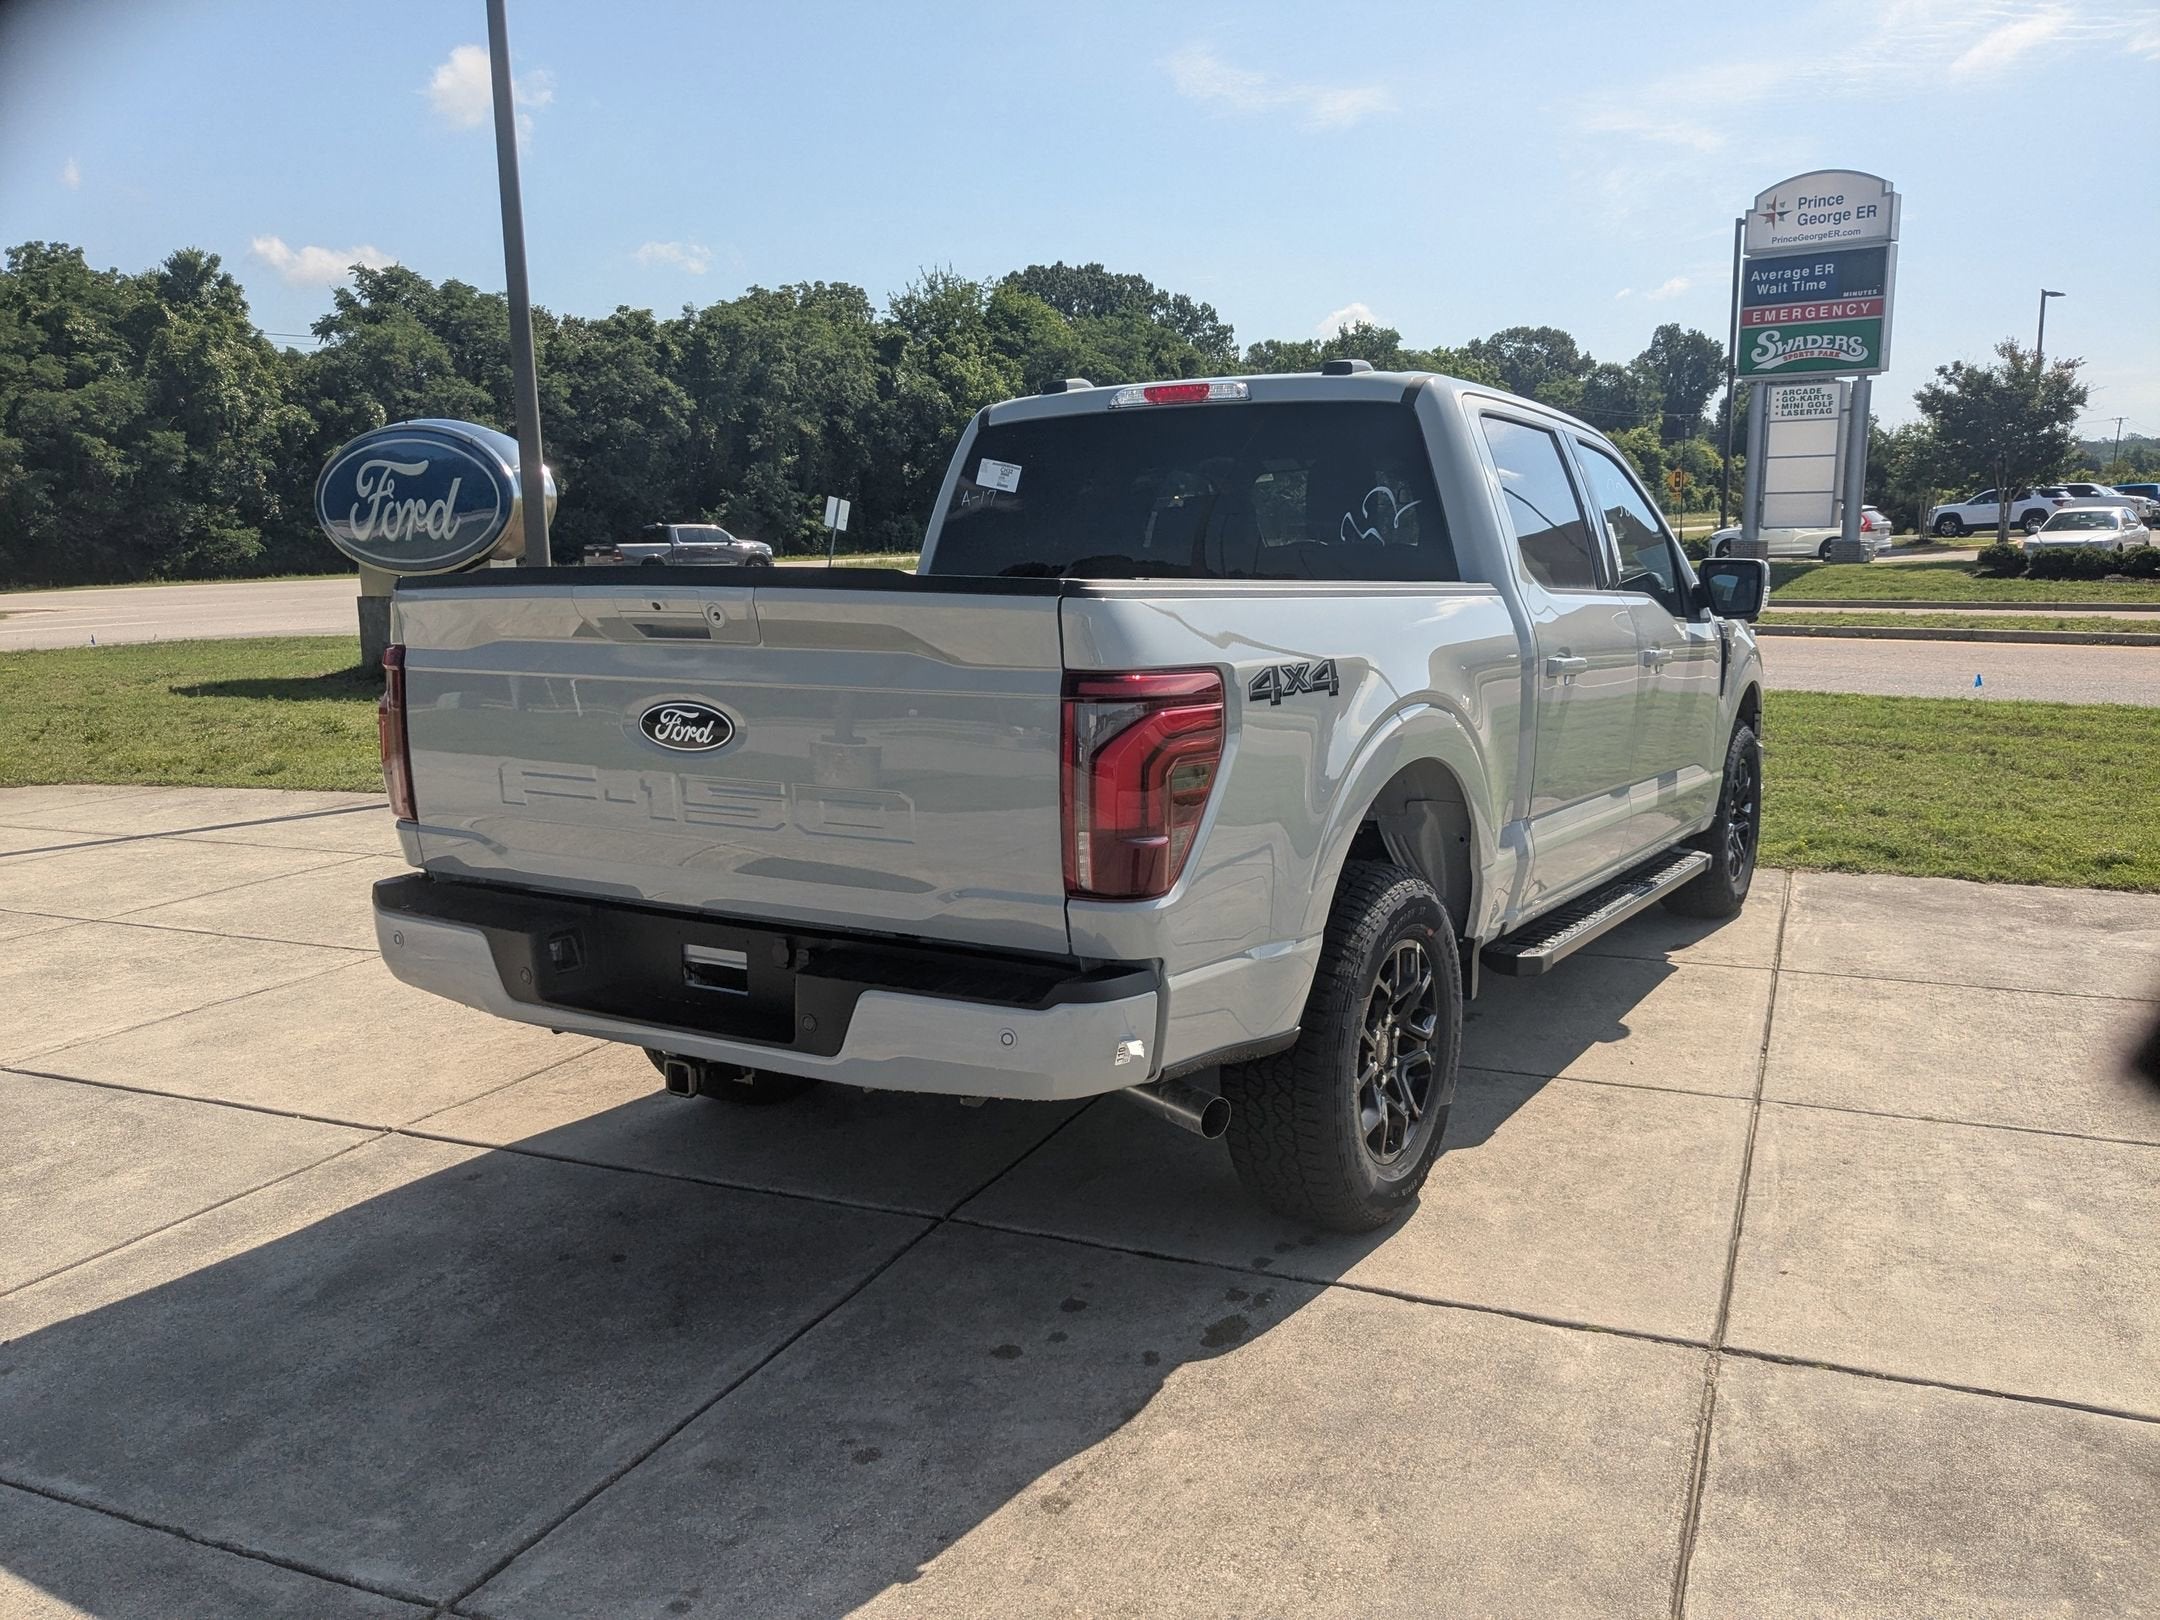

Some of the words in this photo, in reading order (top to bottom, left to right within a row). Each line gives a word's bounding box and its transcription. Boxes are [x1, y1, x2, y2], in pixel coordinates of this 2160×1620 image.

[1798, 194, 1844, 210] Prince
[1797, 211, 1851, 226] George
[1856, 204, 1877, 219] ER
[1771, 228, 1861, 244] PrinceGeorgeER.com
[1751, 267, 1809, 280] Average
[1814, 263, 1835, 276] ER
[1757, 285, 1786, 295] Wait
[1792, 280, 1827, 292] Time
[1843, 289, 1878, 297] MINUTES
[1753, 303, 1870, 322] EMERGENCY
[1782, 351, 1815, 361] SPORTS
[1818, 350, 1841, 358] PARK
[1782, 394, 1833, 403] GO-KARTS
[1781, 408, 1832, 416] LASERTAG
[350, 459, 462, 541] Ford
[655, 709, 714, 744] Ford
[498, 765, 916, 844] F-150
